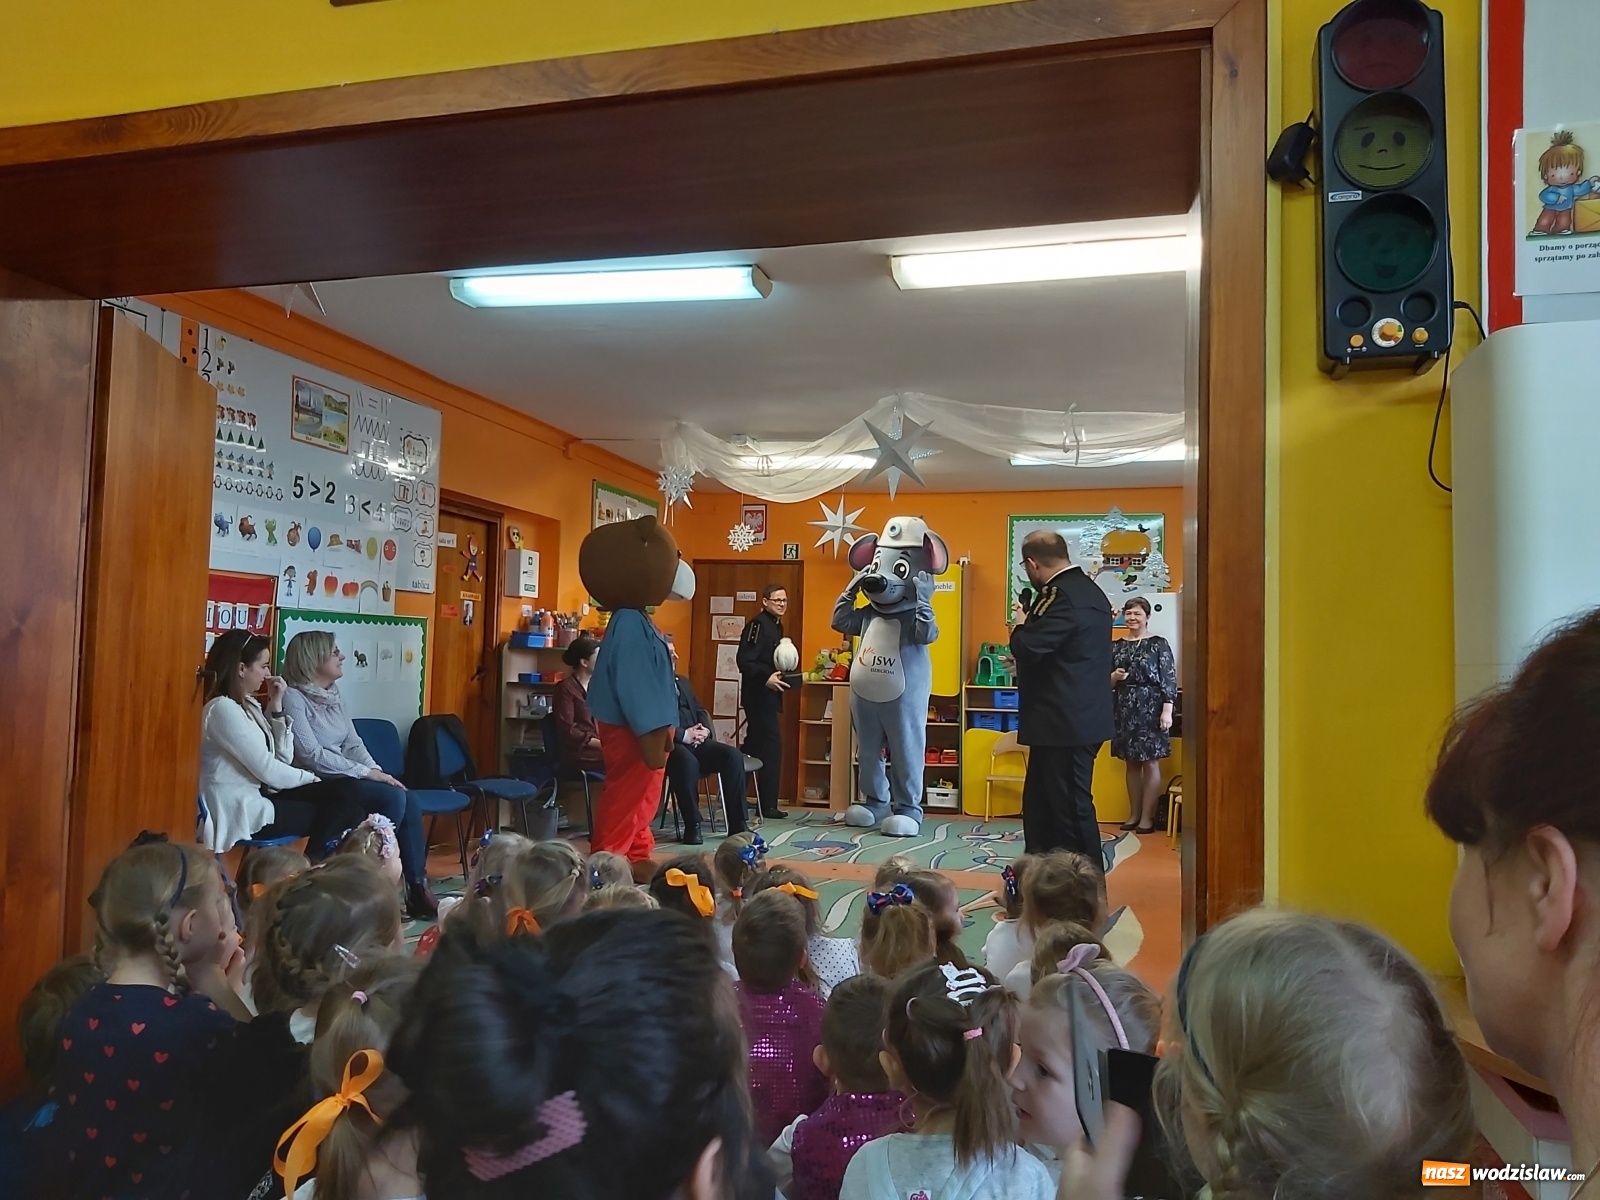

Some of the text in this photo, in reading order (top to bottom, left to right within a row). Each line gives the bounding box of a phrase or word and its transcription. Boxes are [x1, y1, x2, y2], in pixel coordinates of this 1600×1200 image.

[1534, 253, 1574, 263] sprzątamy
[1576, 253, 1586, 261] po
[412, 580, 430, 590] tablica
[237, 610, 248, 625] U
[871, 655, 896, 667] JSW
